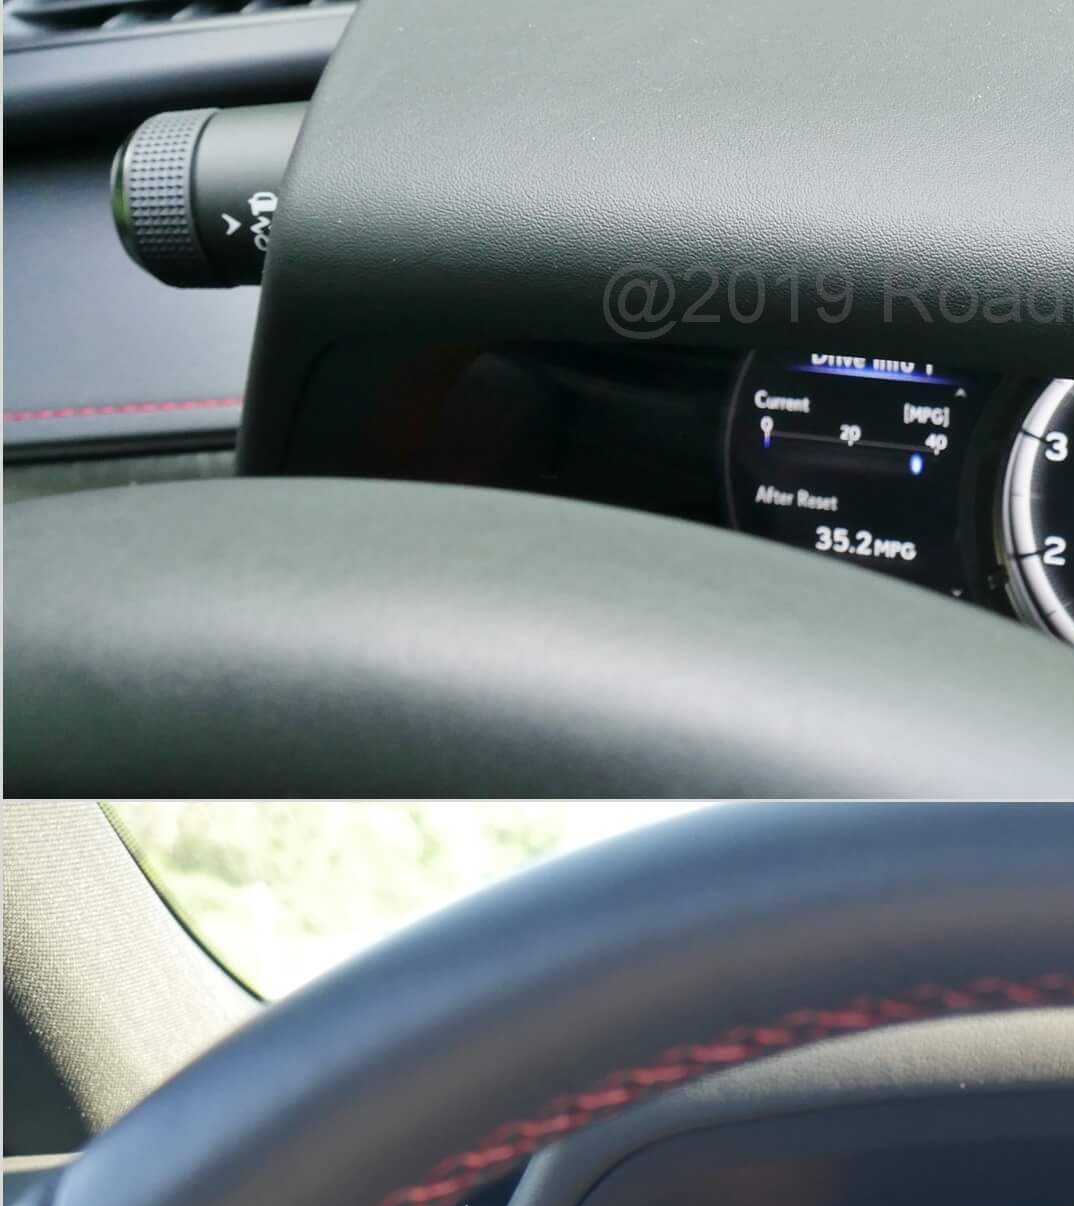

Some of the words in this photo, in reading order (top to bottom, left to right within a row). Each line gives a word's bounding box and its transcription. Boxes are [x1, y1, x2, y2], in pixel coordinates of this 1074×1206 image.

[754, 389, 810, 413] Current
[760, 415, 774, 433] 0
[840, 424, 862, 441] 20
[925, 433, 948, 450] 40
[1044, 432, 1068, 461] 3
[755, 484, 794, 507] After
[797, 488, 839, 512] Reset
[1043, 536, 1066, 566] 2
